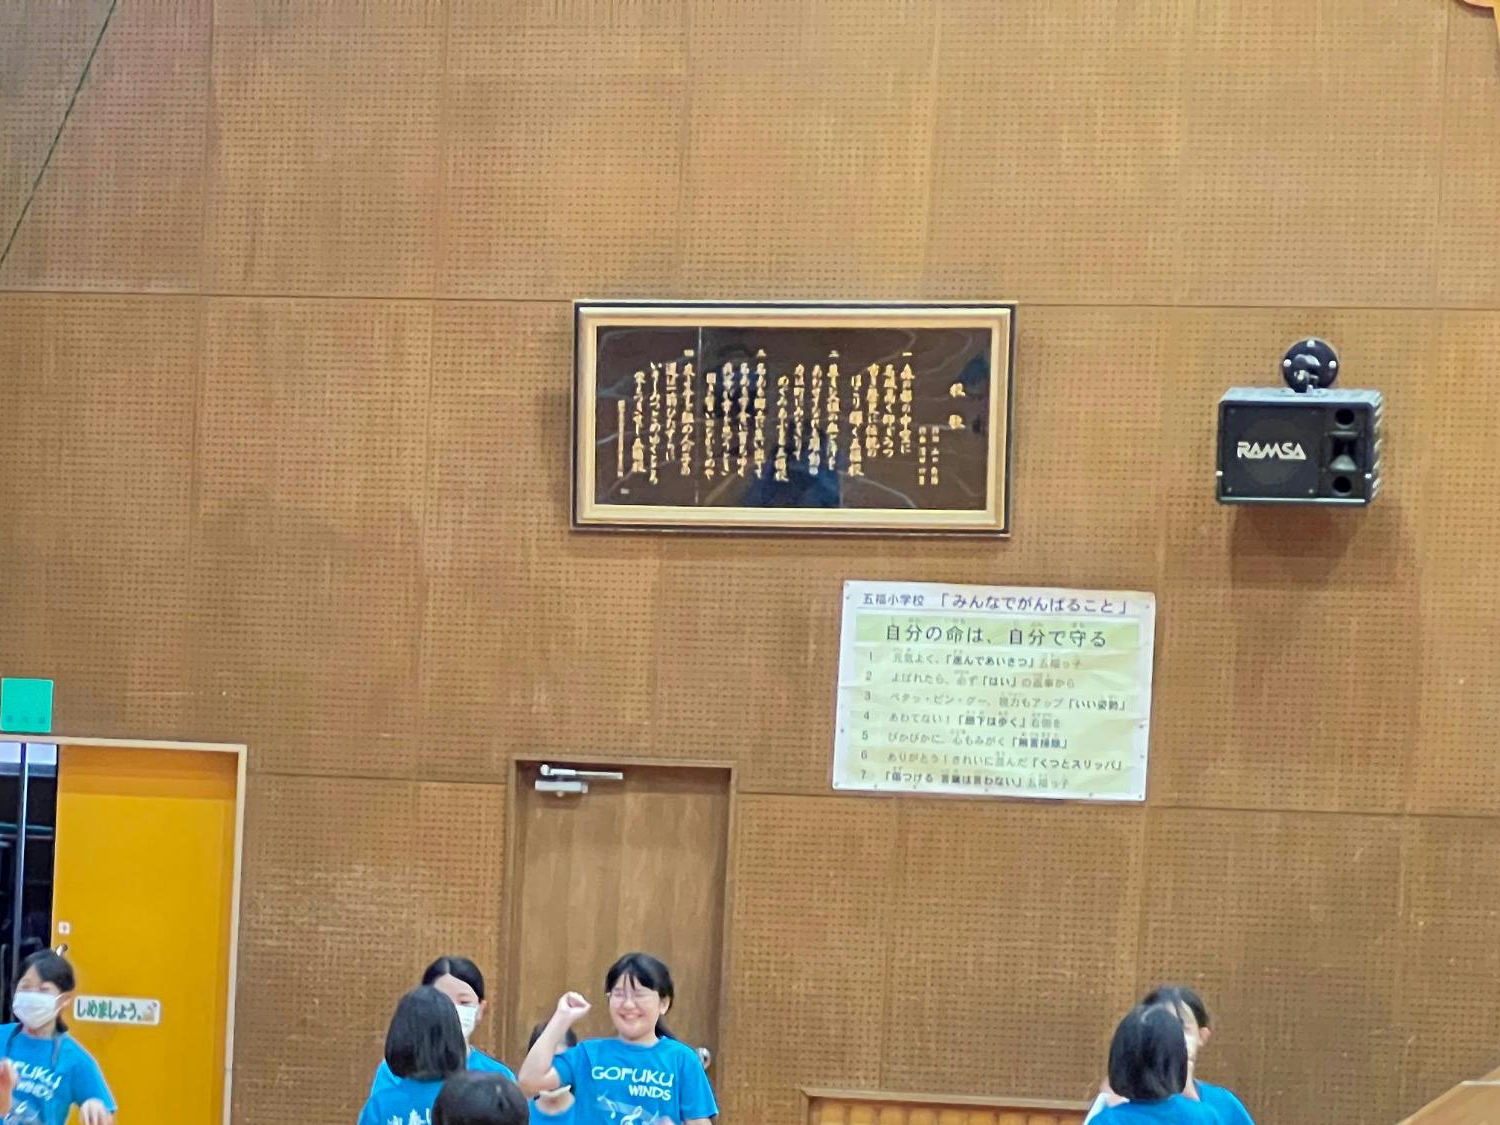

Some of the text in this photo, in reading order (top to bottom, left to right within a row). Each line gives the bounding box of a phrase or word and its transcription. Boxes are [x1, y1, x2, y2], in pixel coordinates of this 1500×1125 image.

[1237, 441, 1306, 460] RAMSA
[862, 592, 1127, 615] 五福小学校 「みんなでがんばること」
[868, 651, 873, 661] 1
[865, 671, 872, 681] 2
[864, 690, 871, 700] 3
[863, 711, 870, 721] 4
[861, 730, 869, 740] 5
[860, 750, 868, 760] 6
[860, 769, 867, 780] 7
[77, 998, 141, 1021] しめましょう。
[591, 1066, 675, 1087] GOFUKU
[628, 1084, 672, 1101] WINDS
